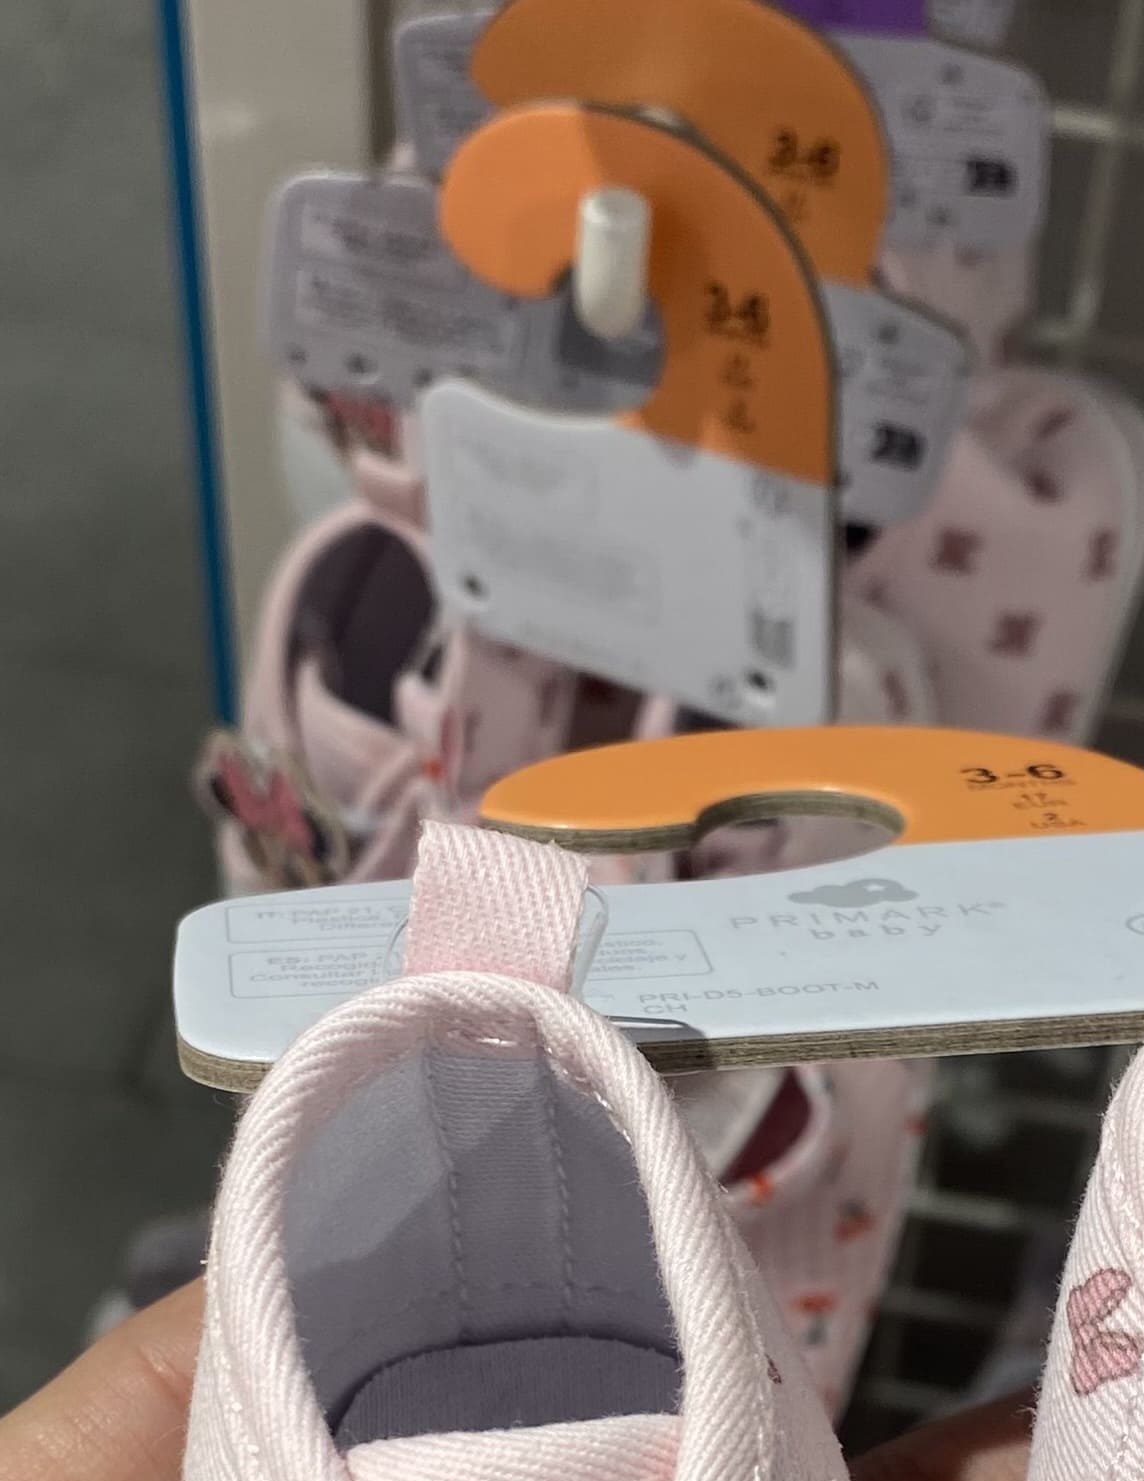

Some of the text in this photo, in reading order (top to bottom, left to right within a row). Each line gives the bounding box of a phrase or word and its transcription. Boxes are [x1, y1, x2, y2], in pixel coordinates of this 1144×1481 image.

[960, 763, 1066, 785] 3-6
[729, 901, 992, 930] PRIMARK
[809, 923, 943, 942] baby
